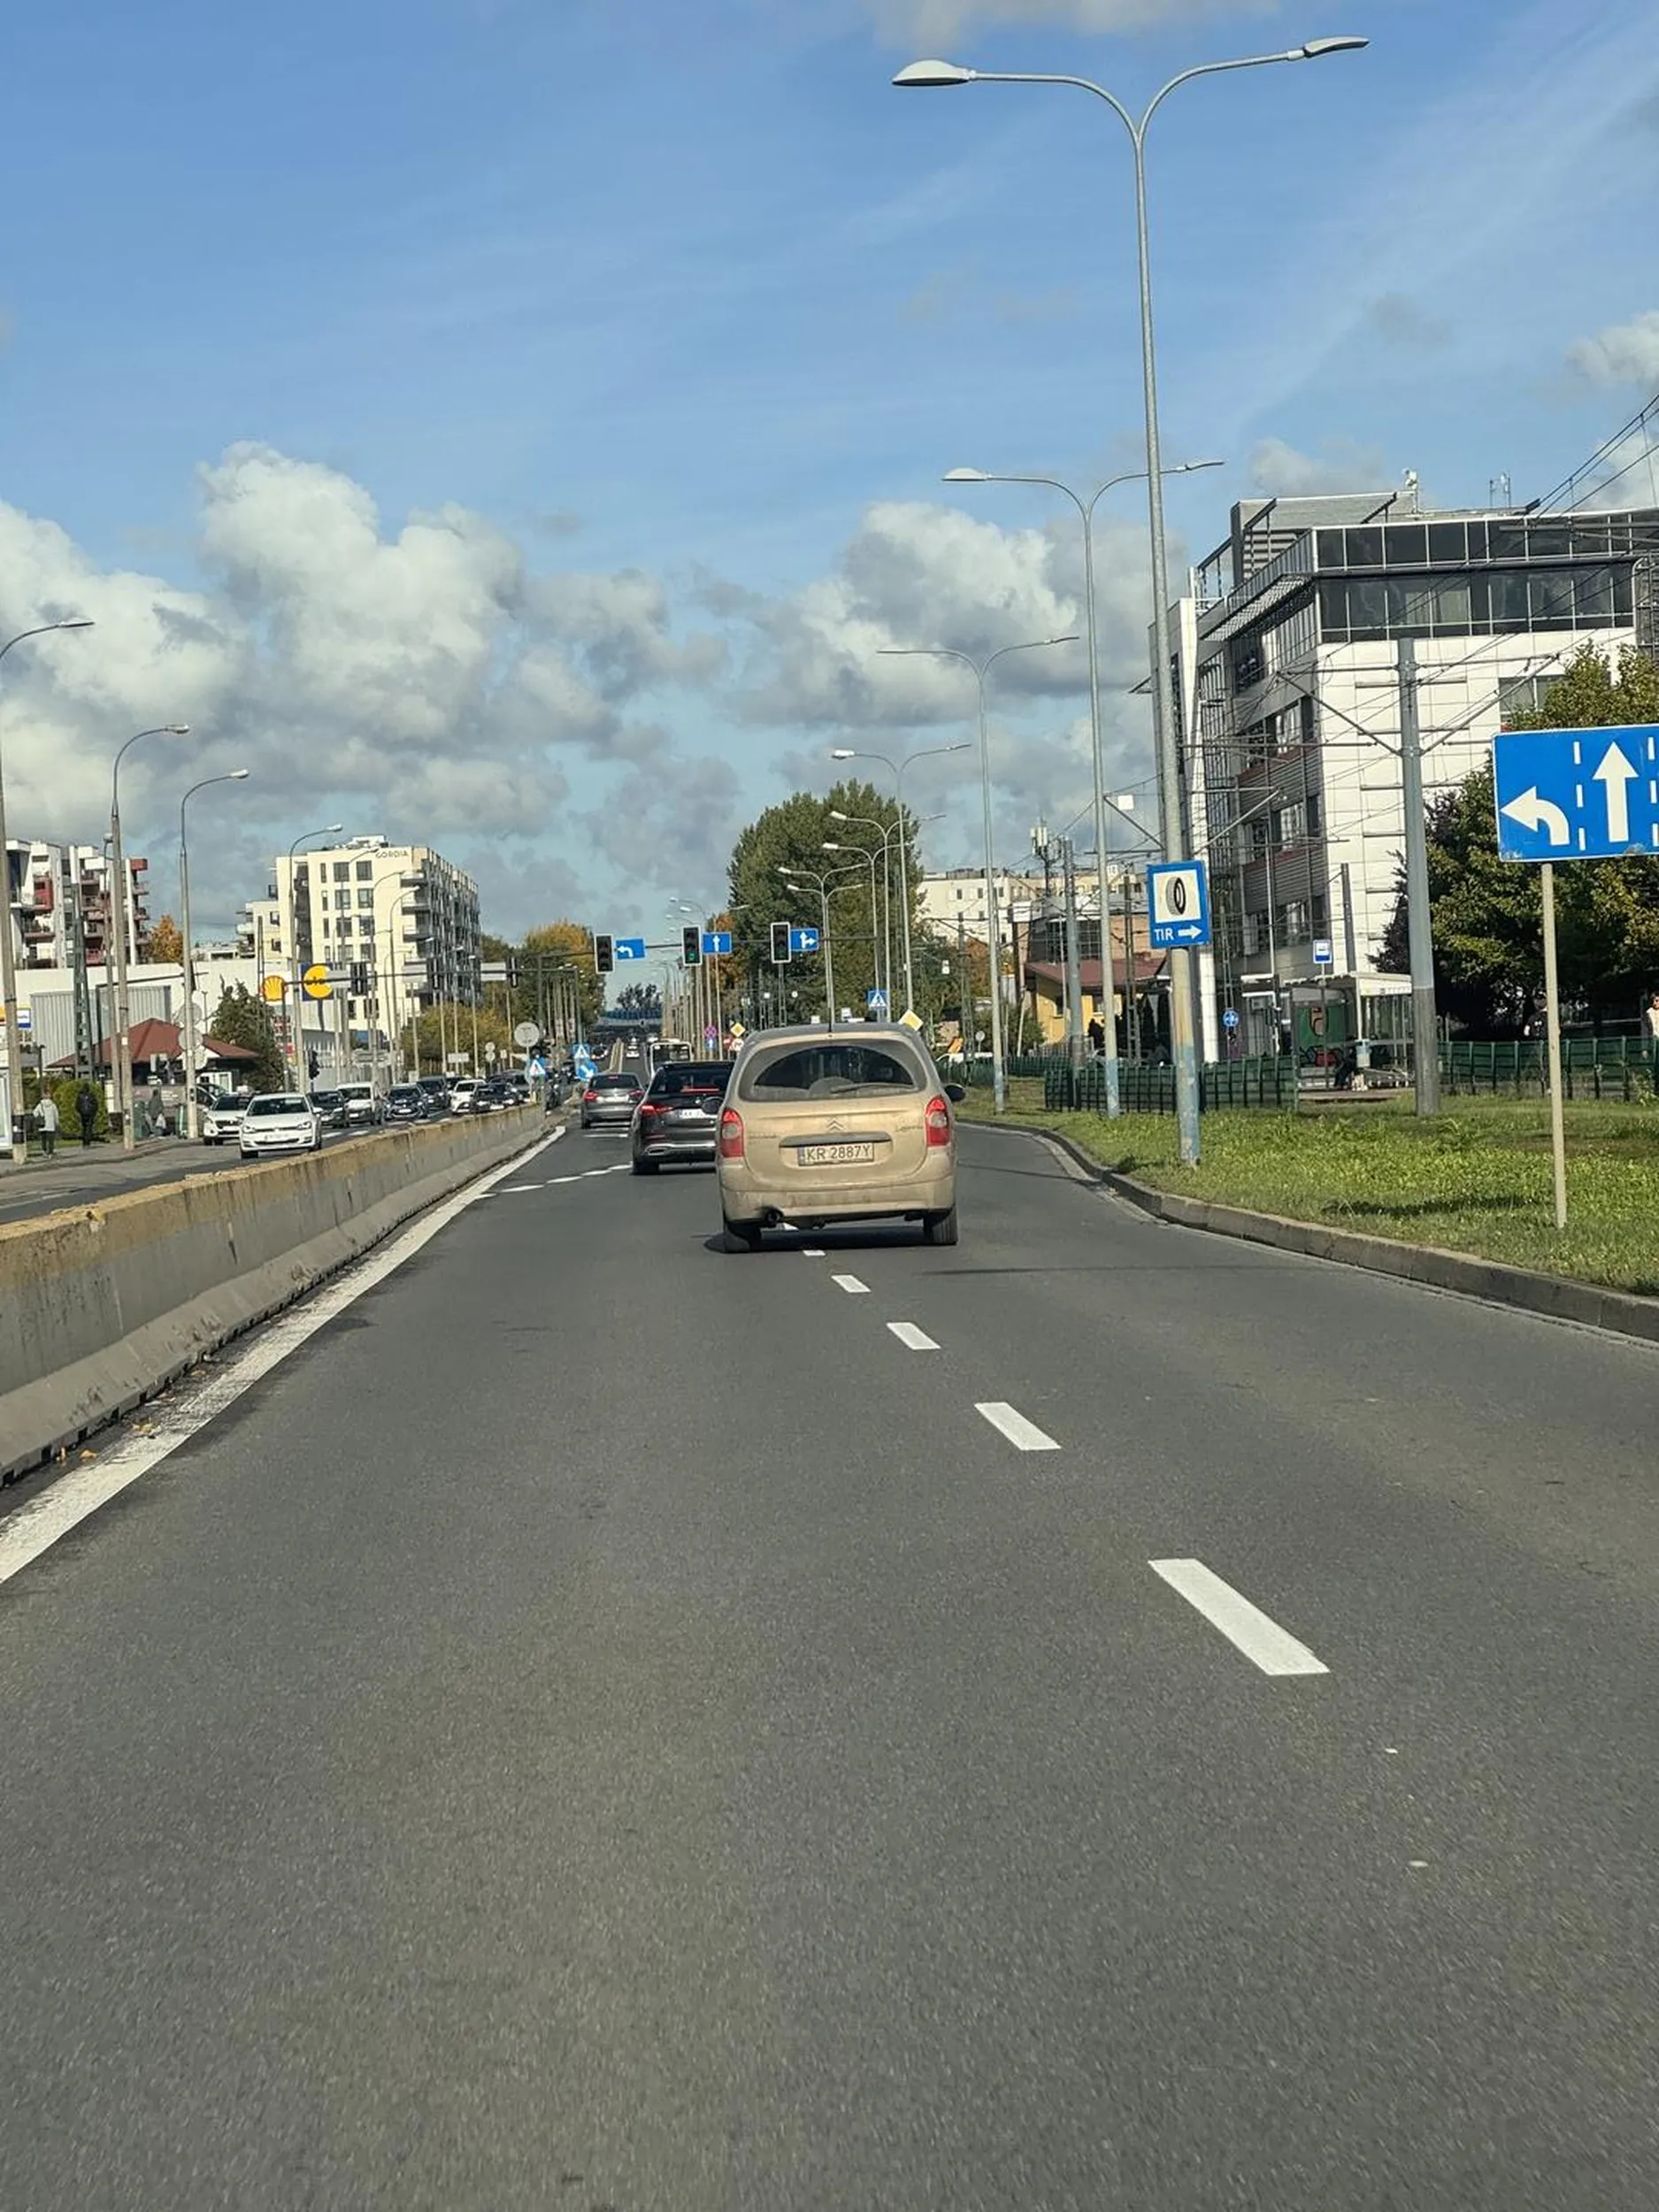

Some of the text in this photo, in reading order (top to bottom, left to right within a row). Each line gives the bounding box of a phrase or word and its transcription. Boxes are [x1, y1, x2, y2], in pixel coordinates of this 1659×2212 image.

[1154, 927, 1175, 941] TIR
[806, 1144, 872, 1161] KR 2887Y
